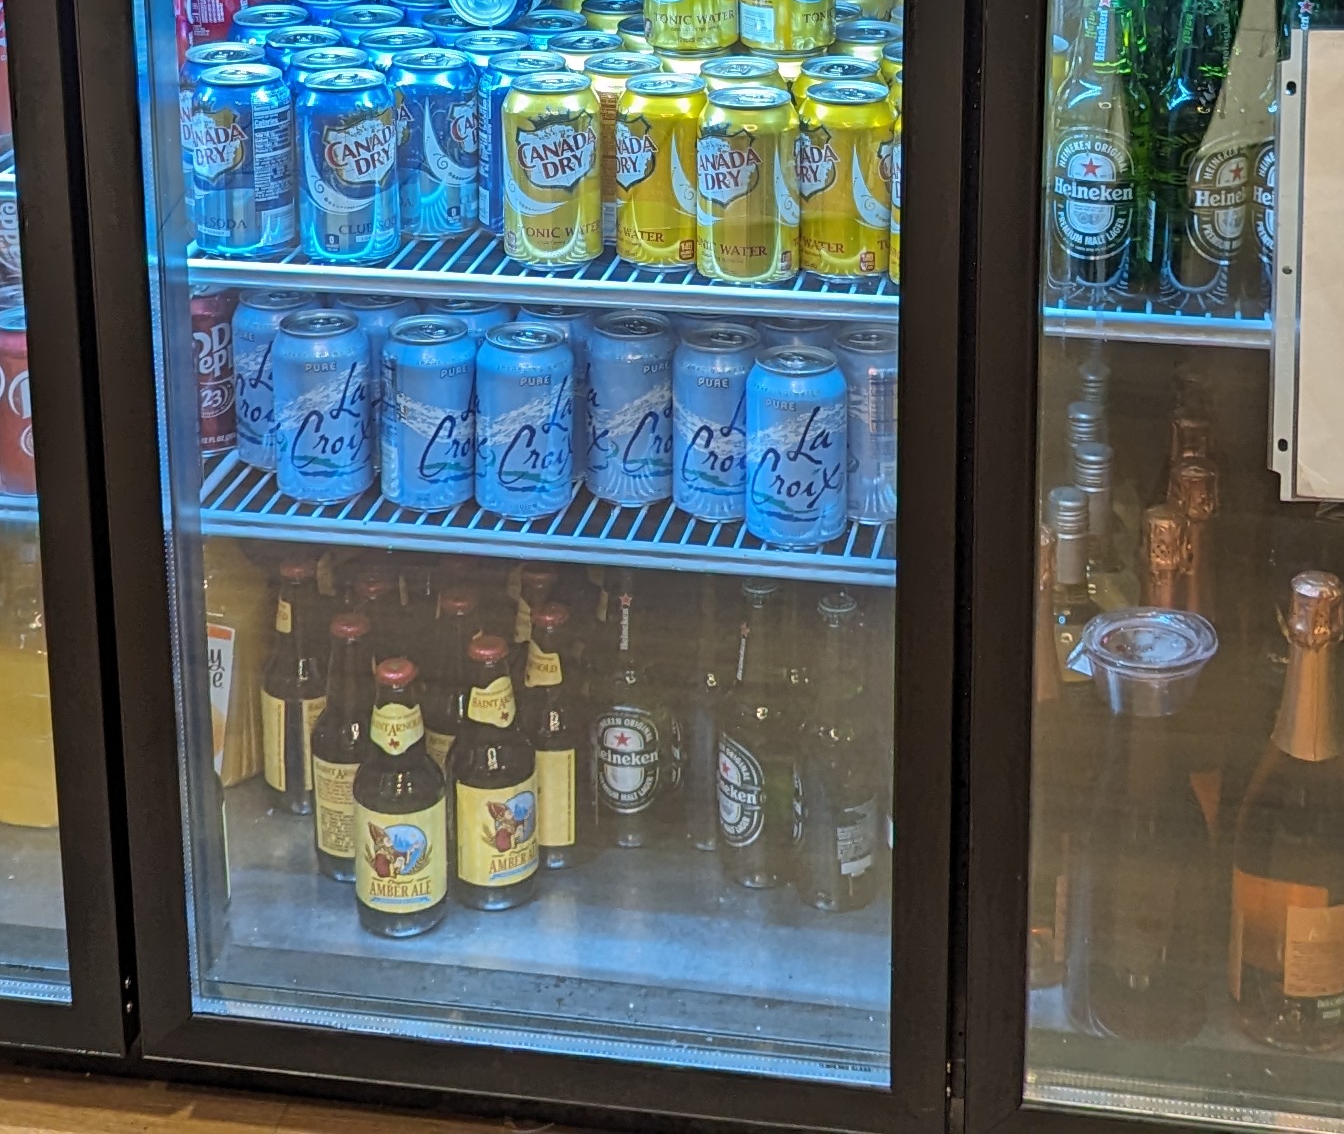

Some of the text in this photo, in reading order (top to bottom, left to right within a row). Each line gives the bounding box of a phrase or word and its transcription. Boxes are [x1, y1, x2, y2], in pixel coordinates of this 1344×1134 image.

[655, 9, 735, 26] TONIC WATER
[1093, 8, 1108, 62] Heineken
[517, 129, 597, 170] CANADA
[1058, 141, 1128, 174] HEINEKEN ORIGINAL
[355, 148, 393, 177] DRY
[541, 152, 589, 180] DRY
[703, 170, 743, 190] DRY
[1054, 177, 1134, 203] Heineken
[338, 224, 373, 236] CLUB
[621, 229, 665, 244] WATER
[1058, 209, 1126, 247] PREMIUM MALT LAGER
[720, 244, 768, 257] WATER
[803, 238, 845, 254] WATER
[305, 361, 338, 373] PURE
[440, 365, 469, 379] PURE
[519, 375, 552, 387] PURE
[697, 376, 730, 389] PURE
[765, 397, 797, 412] PURE
[788, 405, 834, 465] La
[750, 447, 841, 509] Croix
[488, 853, 528, 874] AMBER
[369, 879, 432, 898] AMBER ALE
